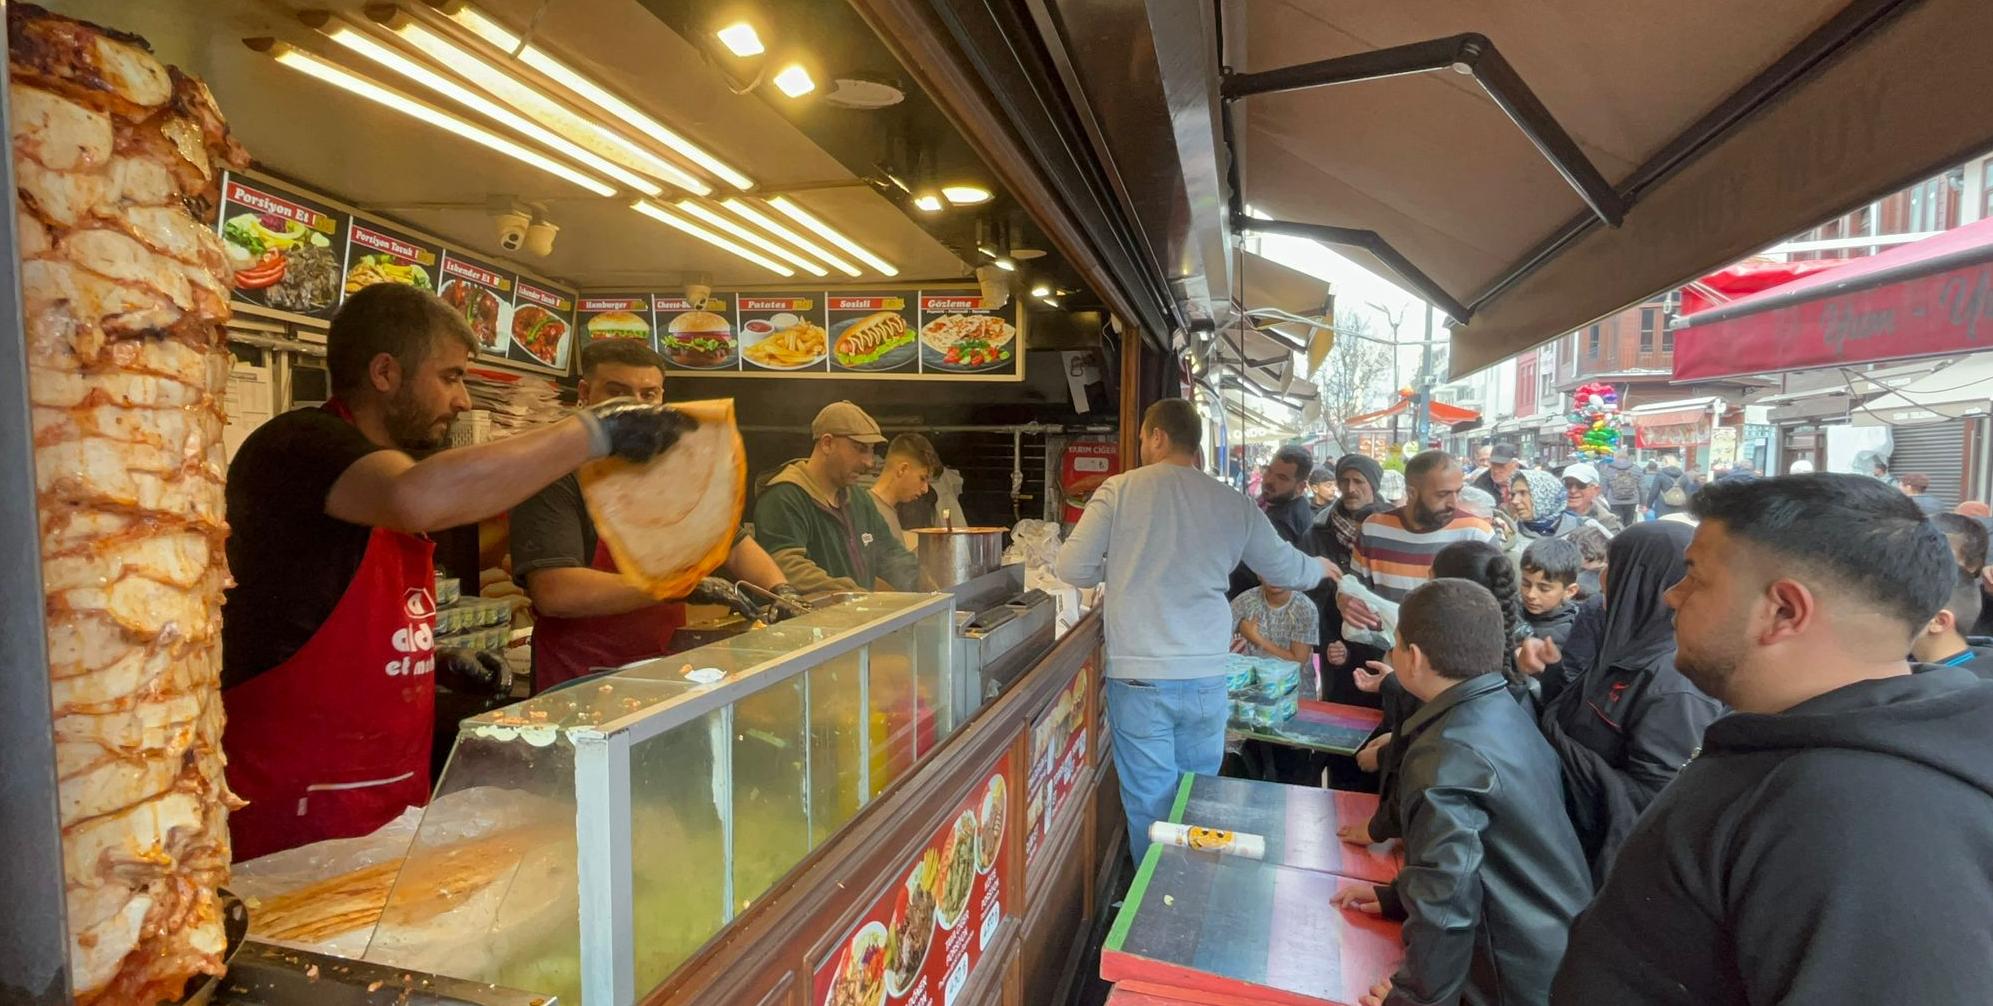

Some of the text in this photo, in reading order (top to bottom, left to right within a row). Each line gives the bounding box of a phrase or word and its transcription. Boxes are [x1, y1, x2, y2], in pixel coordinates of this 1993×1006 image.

[233, 187, 309, 223] Porsiyon Et
[355, 229, 390, 249] Porsiyon
[585, 301, 627, 310] Hamburger
[748, 301, 786, 309] Patates
[839, 299, 871, 308] Sosisli
[385, 656, 411, 676] et
